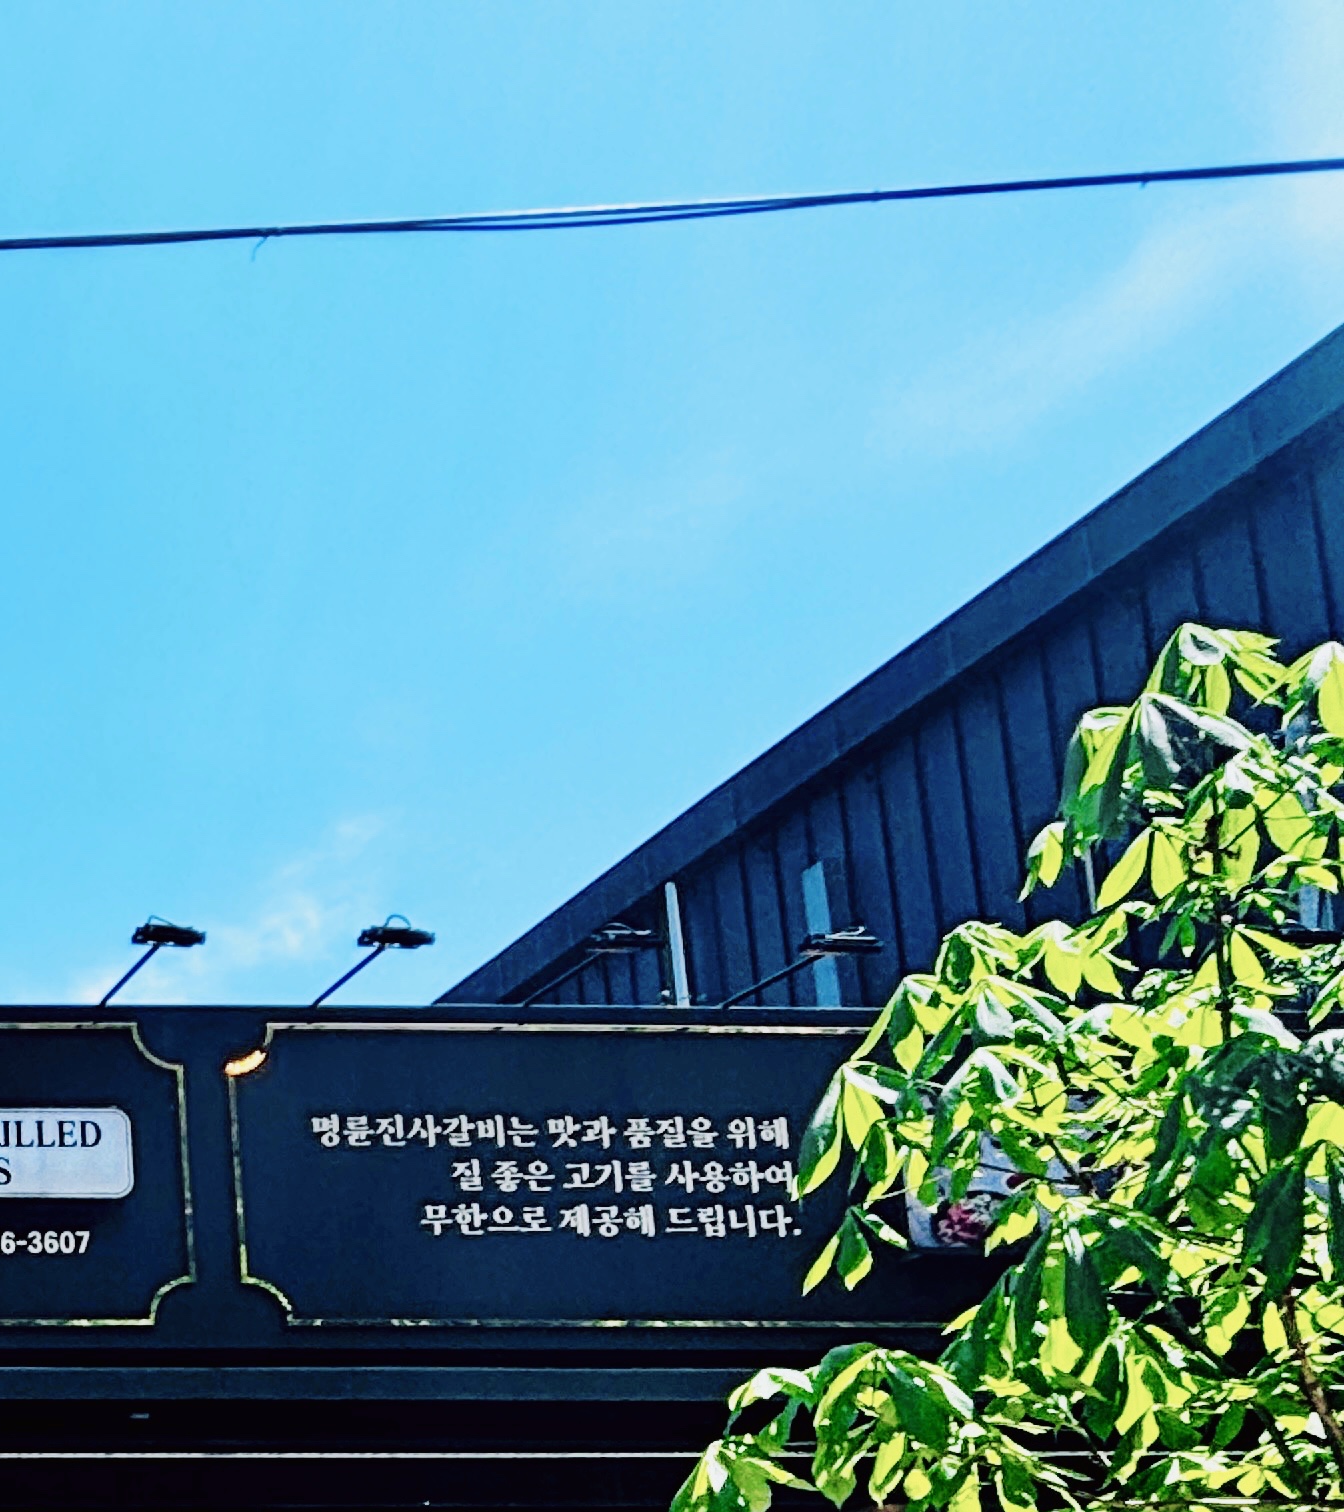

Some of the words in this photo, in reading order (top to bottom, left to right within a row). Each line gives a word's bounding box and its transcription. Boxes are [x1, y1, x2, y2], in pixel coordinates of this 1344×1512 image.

[312, 1115, 539, 1148] 명륜진사갈비는
[547, 1117, 615, 1150] 맛과
[622, 1116, 719, 1150] 품질을
[727, 1117, 789, 1149] 위해
[452, 1161, 483, 1189] 질
[491, 1161, 555, 1190] 좋은
[562, 1162, 656, 1192] 고기를
[665, 1162, 794, 1194] 사용하여
[420, 1206, 552, 1235] 무한으로
[559, 1206, 655, 1237] 제공해
[665, 1206, 802, 1238] 드립니다.
